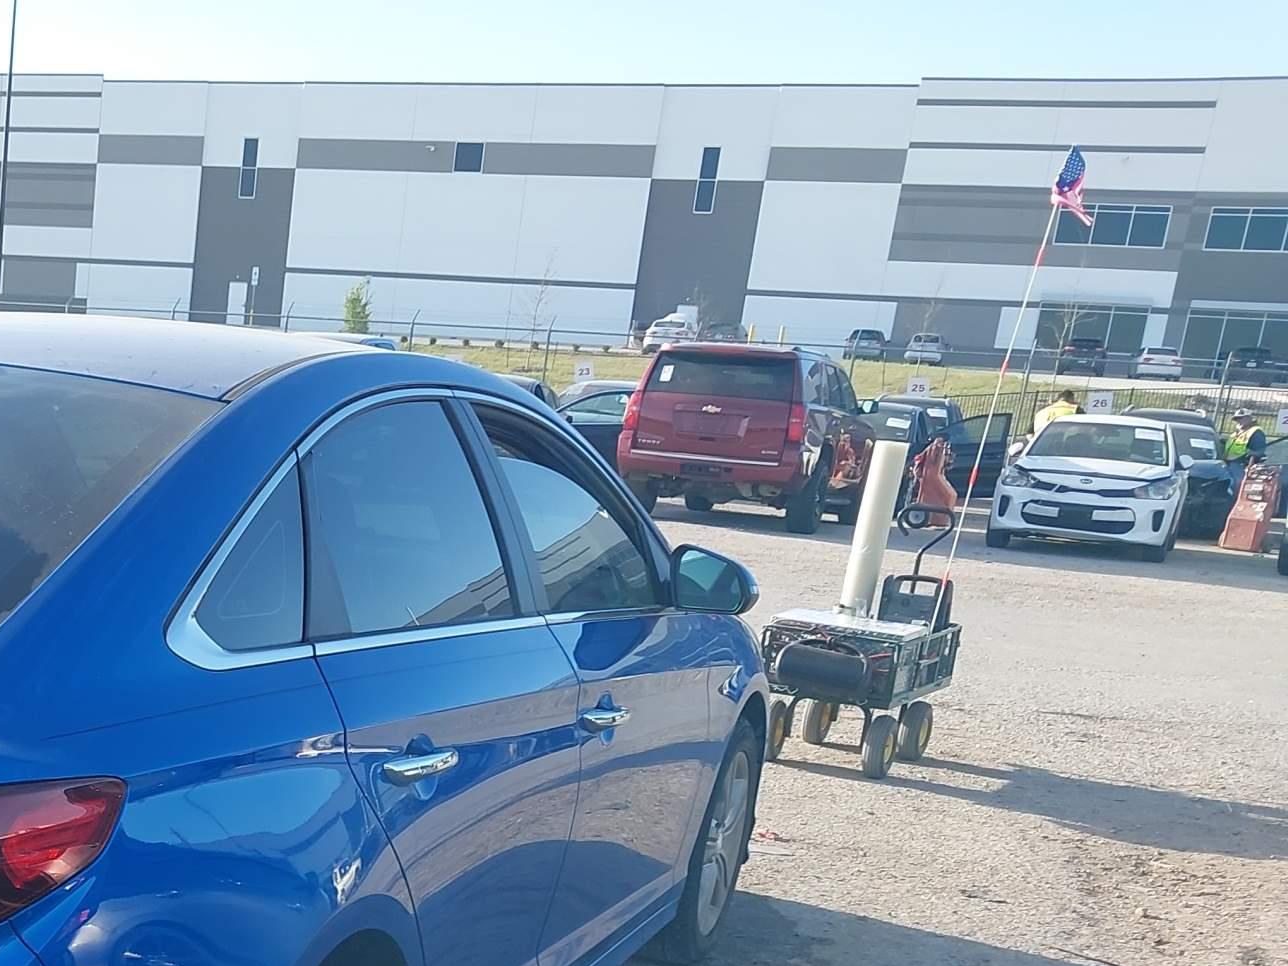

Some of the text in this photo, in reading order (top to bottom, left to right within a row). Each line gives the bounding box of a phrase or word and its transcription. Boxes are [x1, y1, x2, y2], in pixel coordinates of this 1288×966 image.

[578, 367, 591, 376] 23
[912, 383, 925, 393] 25
[1092, 399, 1108, 408] 26
